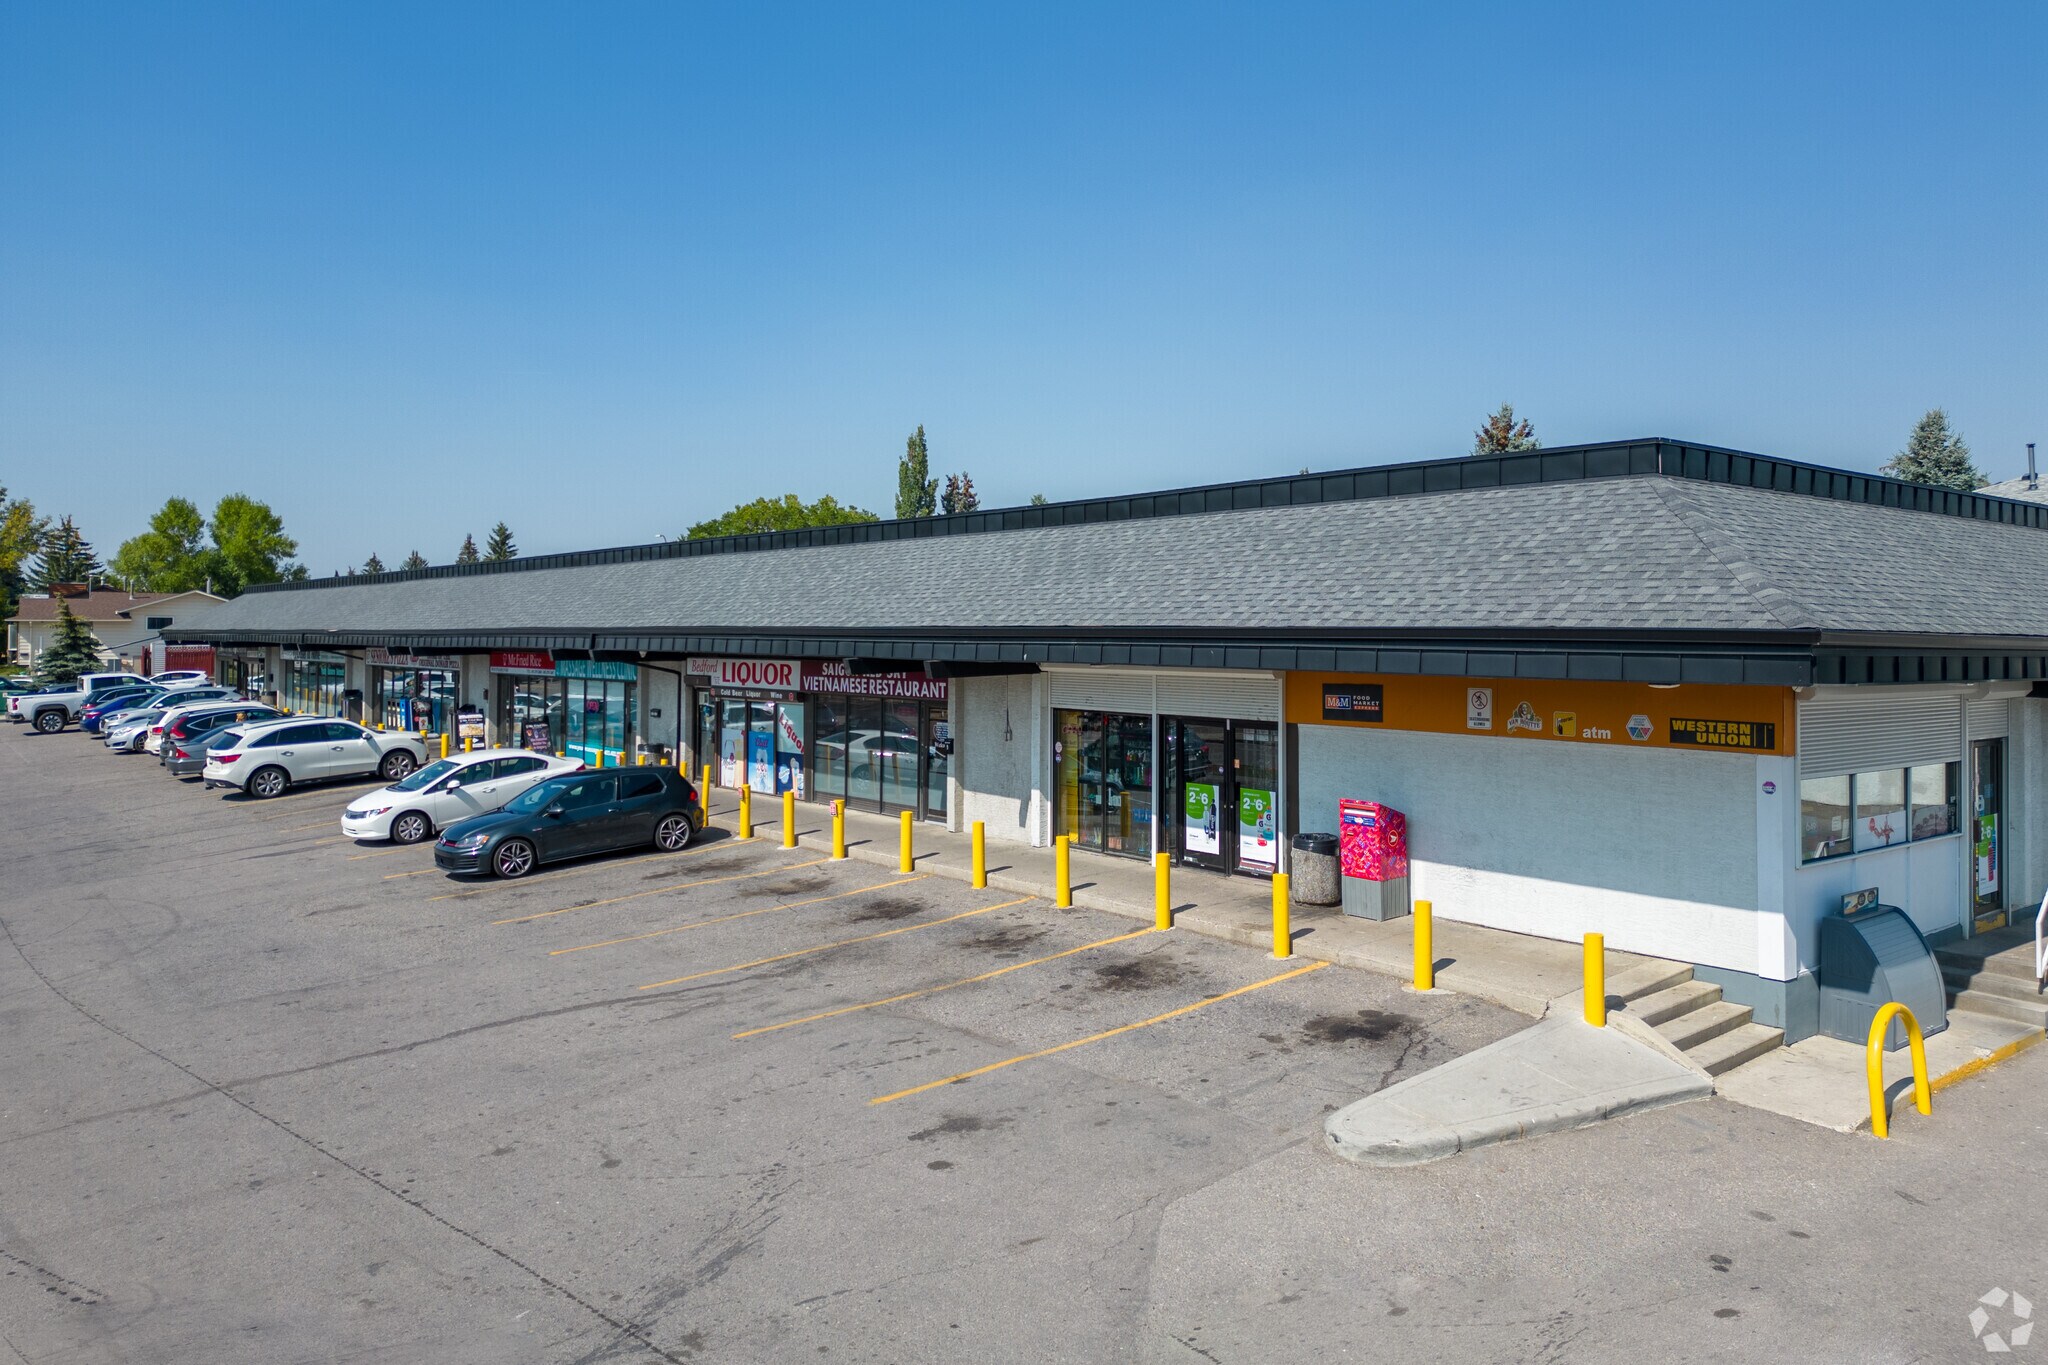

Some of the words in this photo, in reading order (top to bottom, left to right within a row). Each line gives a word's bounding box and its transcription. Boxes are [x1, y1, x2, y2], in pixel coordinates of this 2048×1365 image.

[530, 654, 542, 668] Rice
[692, 660, 719, 675] Bedford
[722, 661, 793, 687] LIQUOR
[721, 689, 731, 697] Cold
[732, 689, 743, 697] Beer
[746, 690, 761, 699] Liquor
[803, 676, 868, 695] VIETNAMESE
[869, 679, 947, 699] RESTAURANT
[1327, 697, 1349, 707] M&M
[1509, 719, 1519, 727] VAN
[1672, 719, 1751, 735] WESTERN
[1582, 726, 1612, 740] atm
[1696, 732, 1751, 746] UNION
[1189, 791, 1196, 803] 2
[1243, 797, 1251, 810] 2
